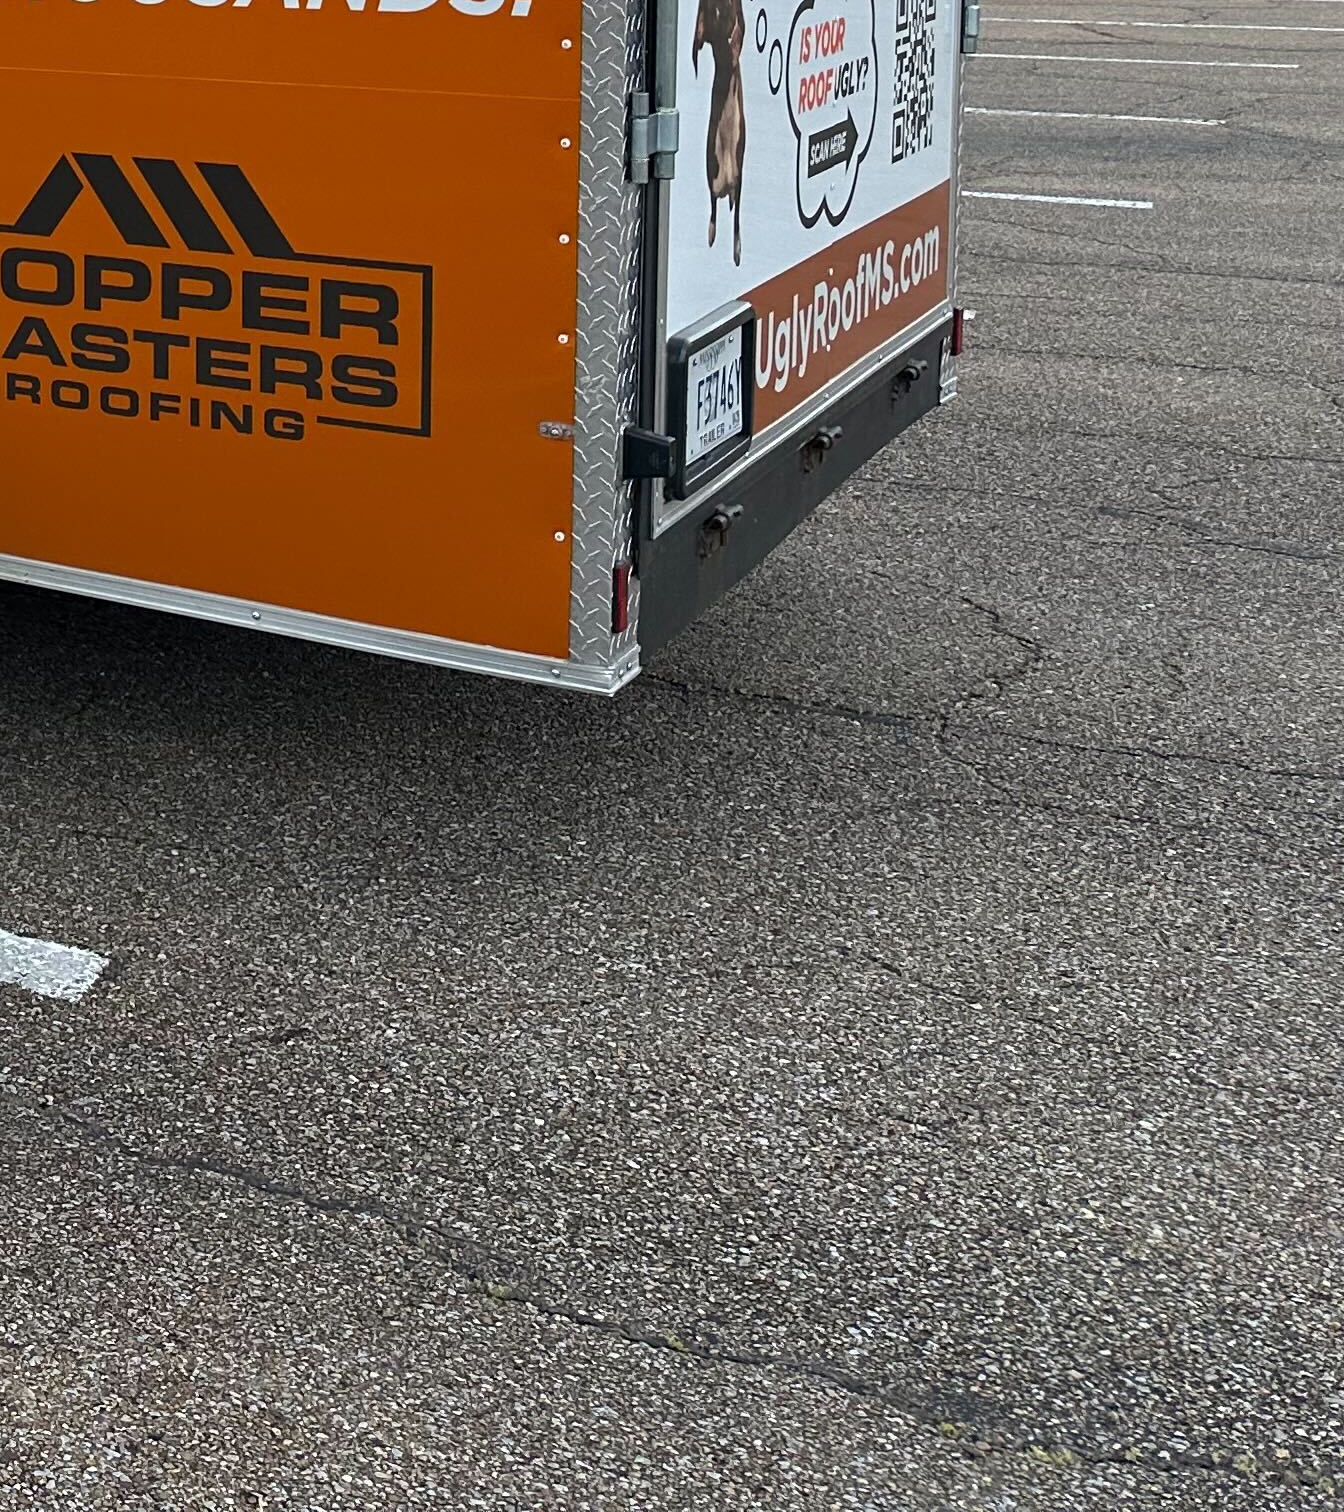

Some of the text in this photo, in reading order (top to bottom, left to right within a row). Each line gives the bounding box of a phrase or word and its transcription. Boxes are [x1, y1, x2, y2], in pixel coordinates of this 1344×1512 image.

[799, 17, 846, 64] IS YOUR
[798, 56, 869, 115] ROOF UGLY?
[810, 138, 829, 166] SCAN
[755, 223, 940, 392] UglyRoofMS.com
[6, 373, 306, 441] ROOFING
[699, 422, 725, 449] TRAILER
